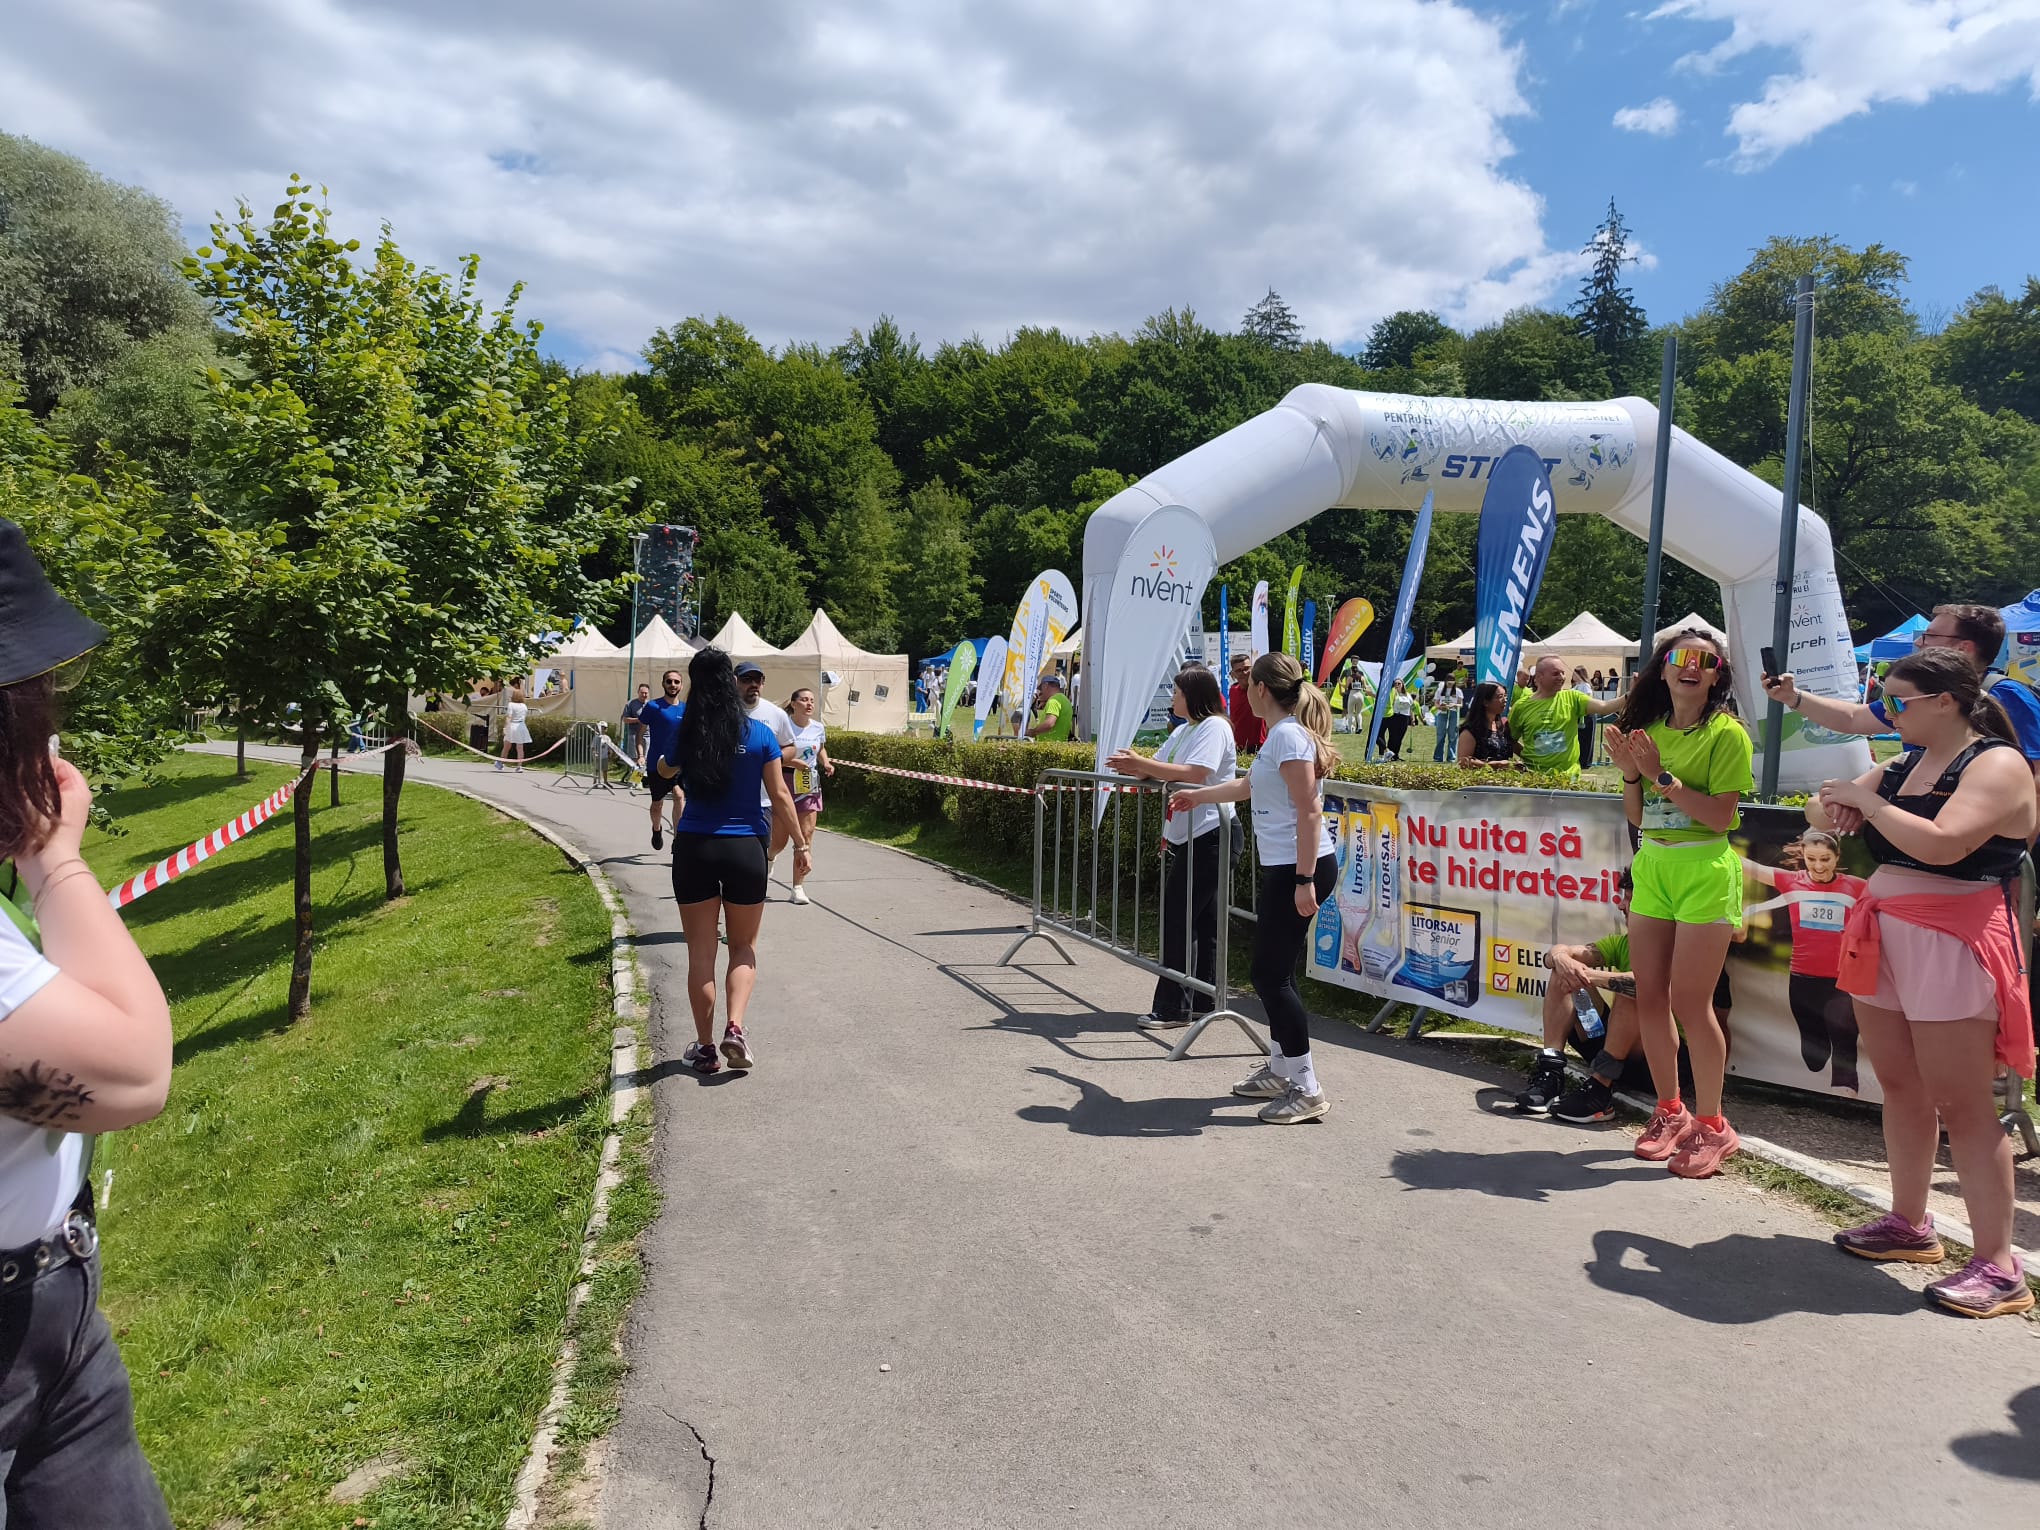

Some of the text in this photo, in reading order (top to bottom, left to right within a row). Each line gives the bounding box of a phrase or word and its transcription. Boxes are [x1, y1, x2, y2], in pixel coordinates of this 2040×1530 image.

[1441, 454, 1562, 480] STT
[1486, 478, 1553, 682] EMENS
[1790, 635, 1827, 654] preh
[1796, 664, 1835, 675] Benchmark
[1406, 815, 1582, 859] Nu uita să
[1351, 825, 1363, 895] LITORSAL
[1381, 830, 1391, 909] LITORSAL
[1407, 855, 1623, 905] te hidratezi!
[1411, 915, 1462, 935] LITORSAL
[1812, 907, 1832, 920] 328
[1429, 931, 1461, 946] Senior
